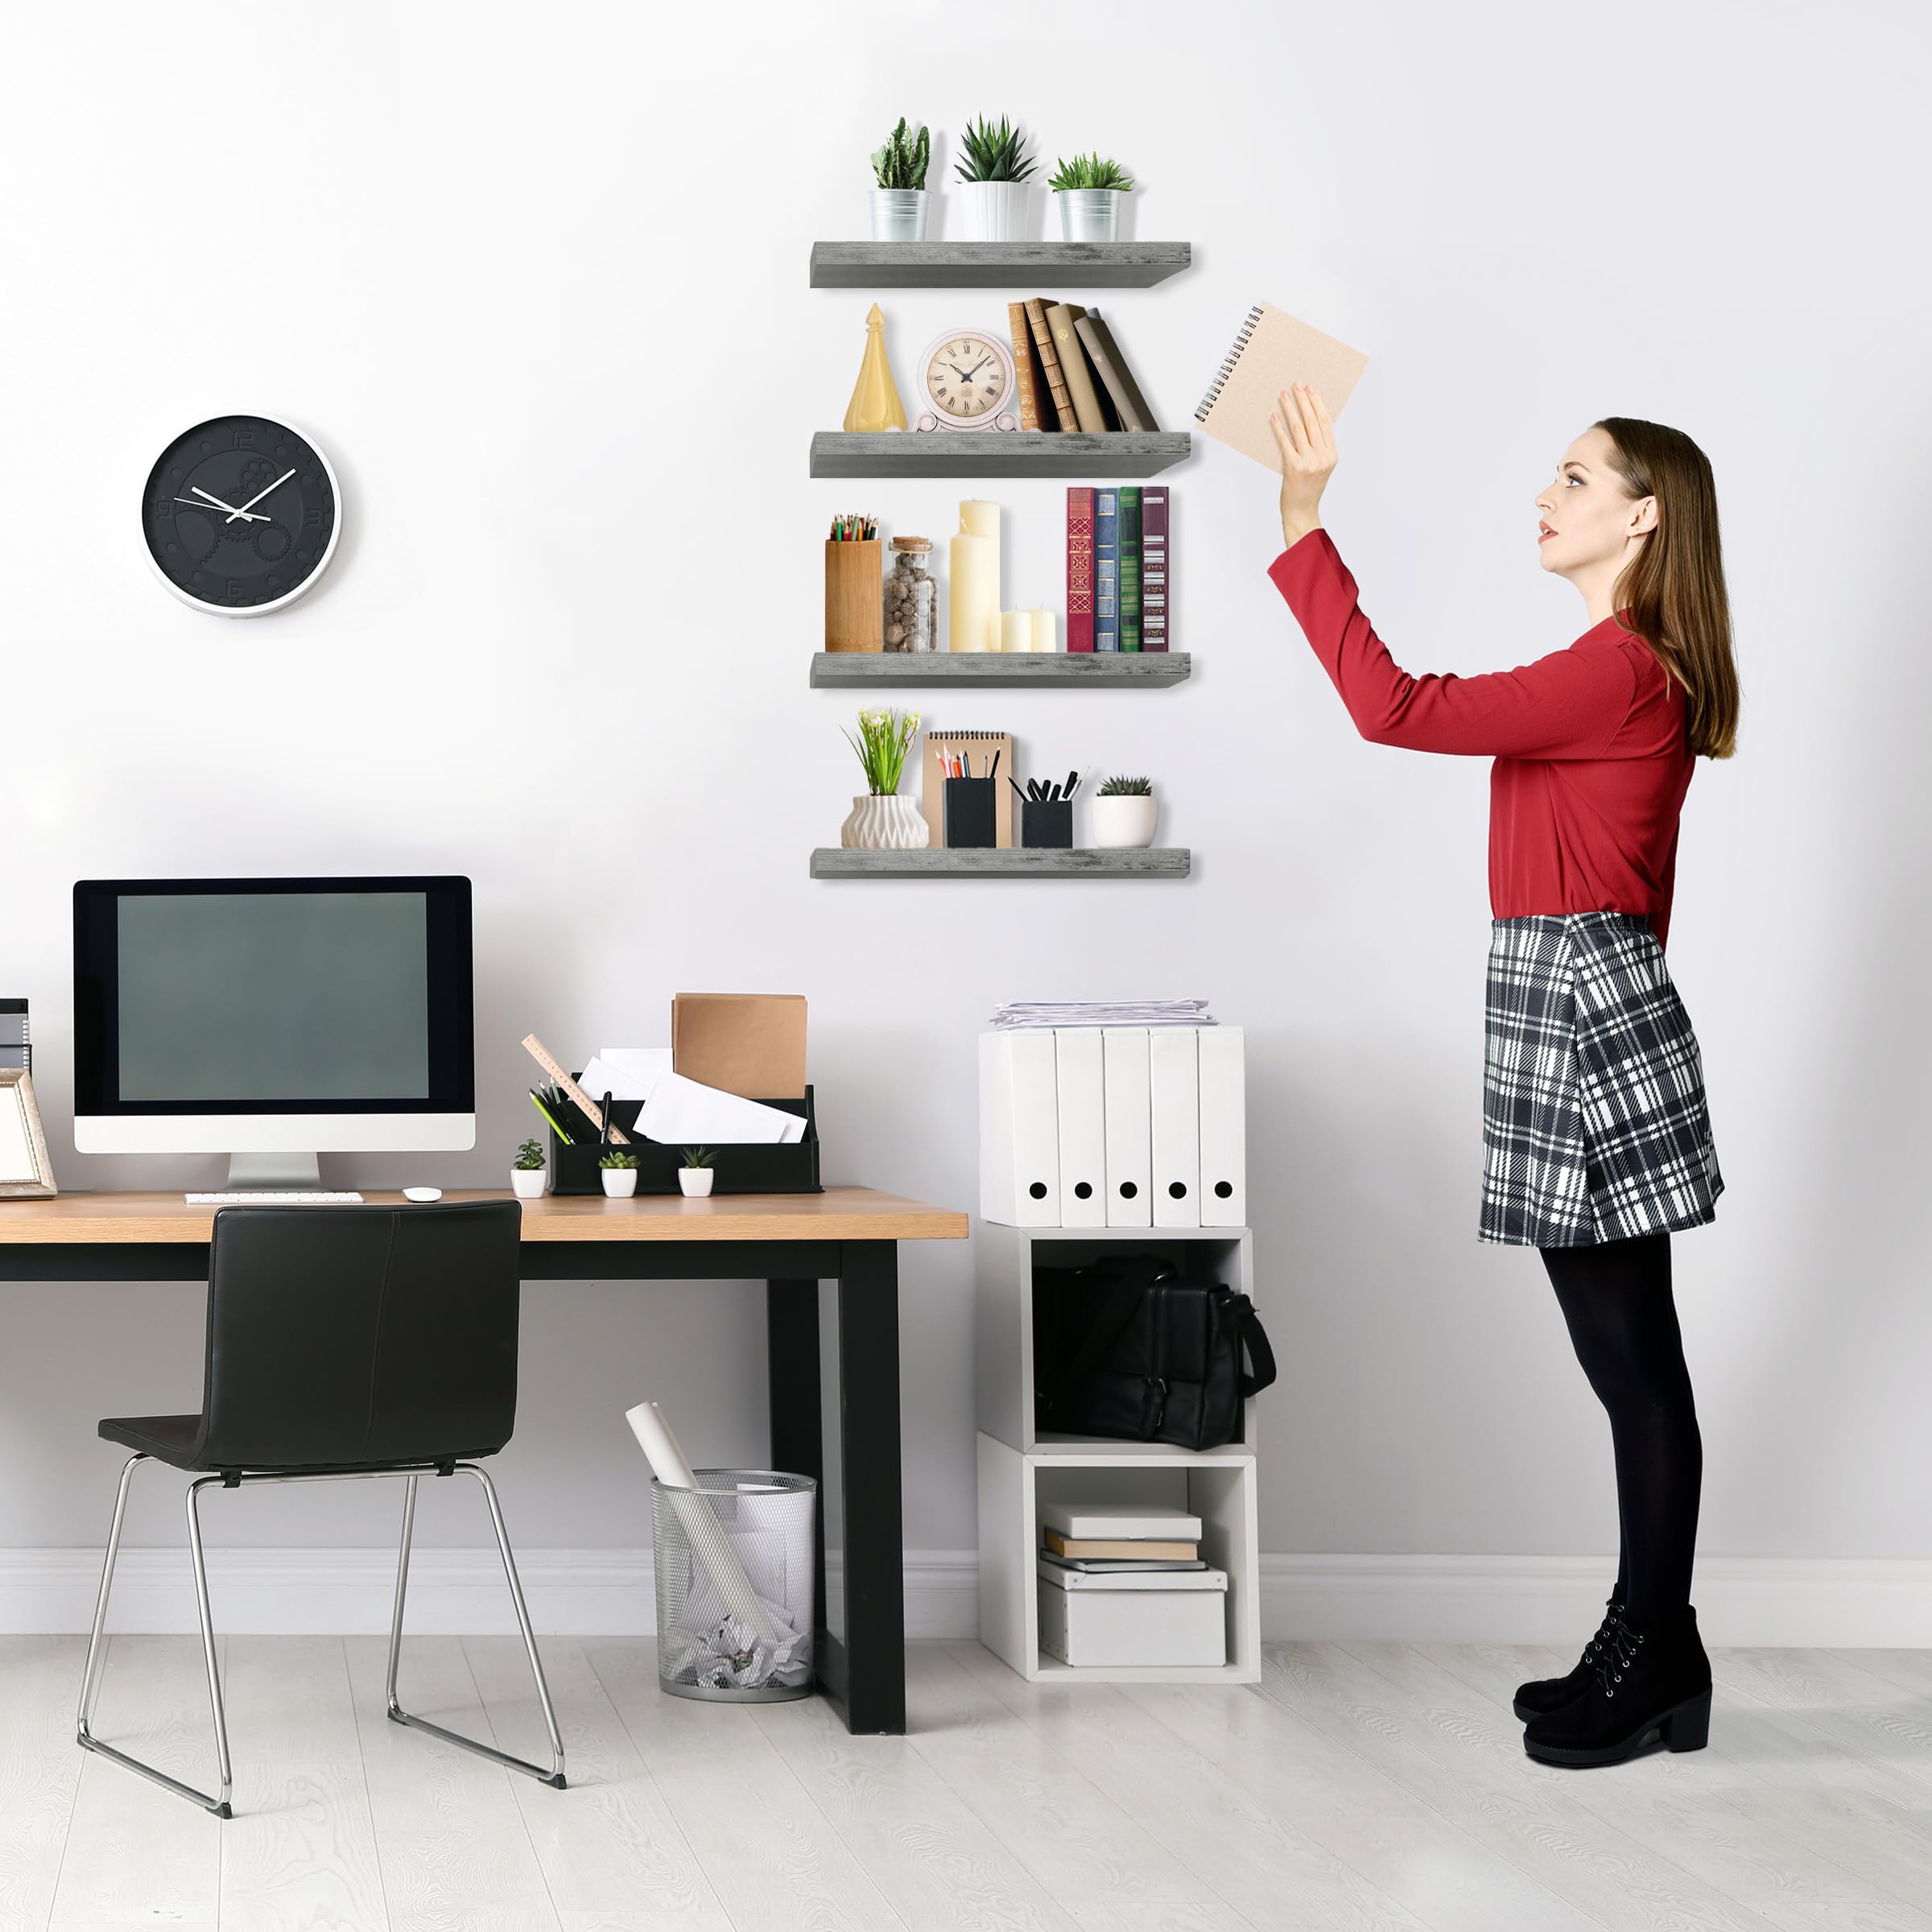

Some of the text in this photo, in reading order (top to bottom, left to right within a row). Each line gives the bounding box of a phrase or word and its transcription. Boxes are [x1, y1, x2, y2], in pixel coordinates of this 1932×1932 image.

[232, 431, 253, 450] 12
[155, 500, 173, 518] 9
[304, 508, 321, 527] 3
[225, 579, 242, 597] 6
